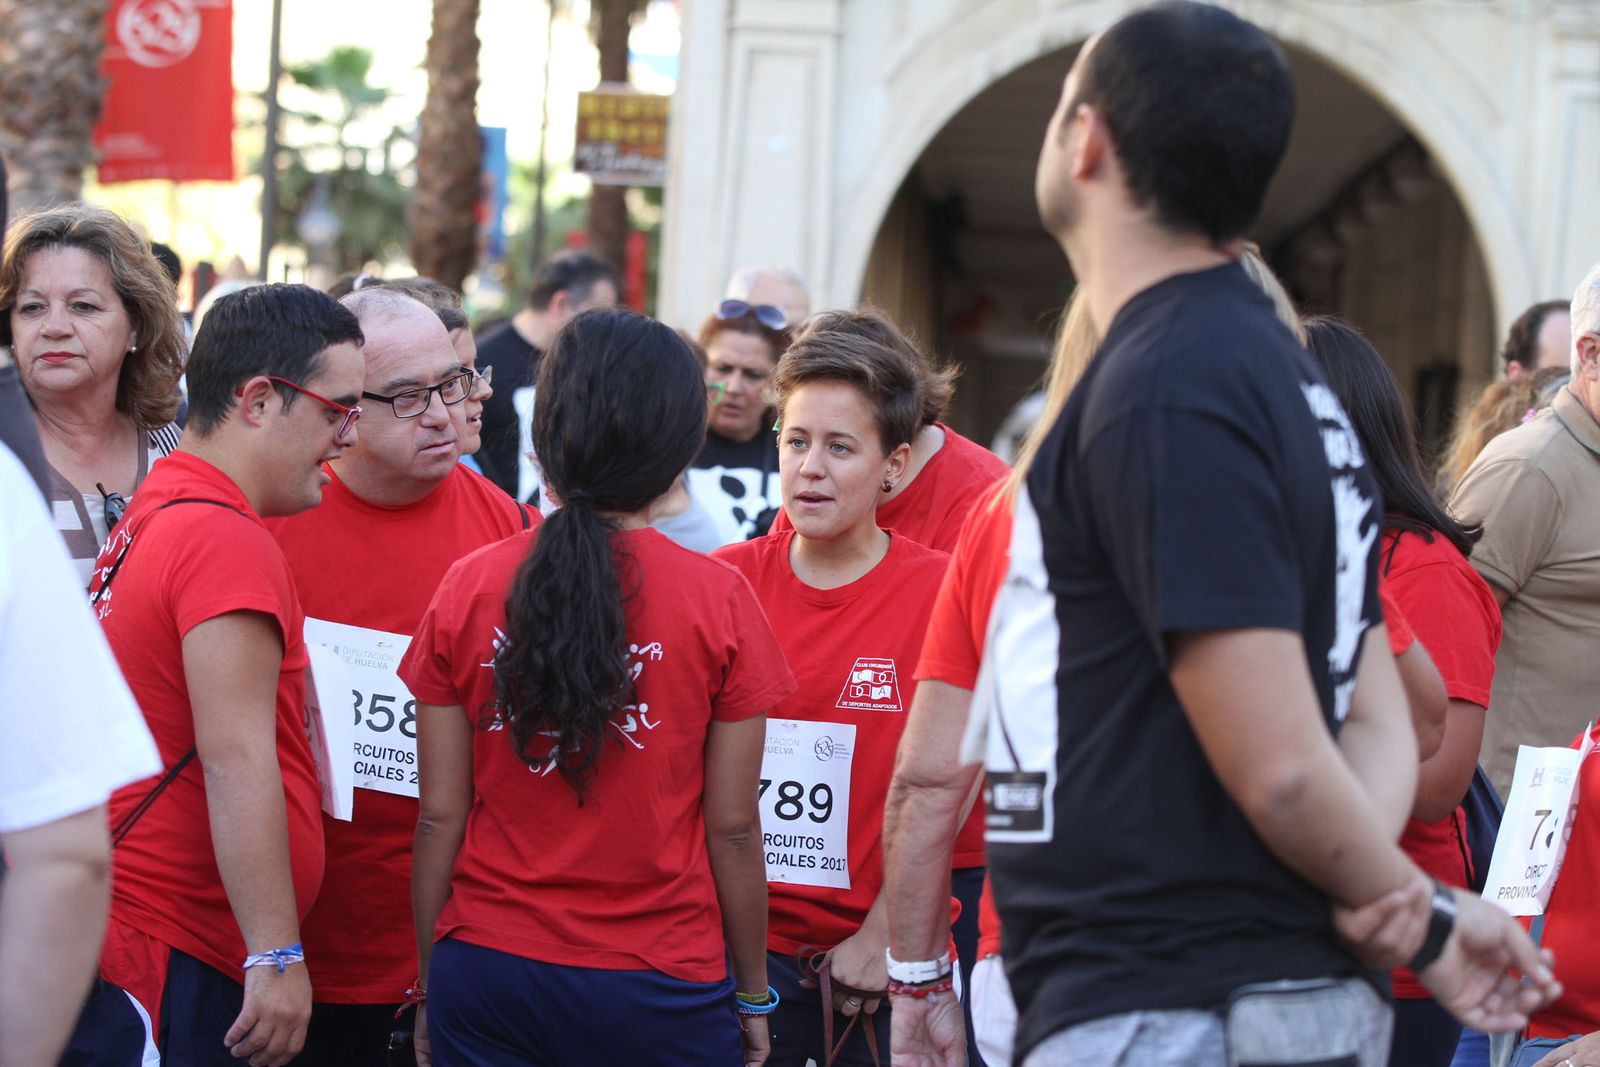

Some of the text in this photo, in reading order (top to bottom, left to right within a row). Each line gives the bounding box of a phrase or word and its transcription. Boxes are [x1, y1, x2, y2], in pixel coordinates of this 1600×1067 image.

[341, 656, 388, 669] DE HUELVA
[820, 856, 846, 871] 2017
